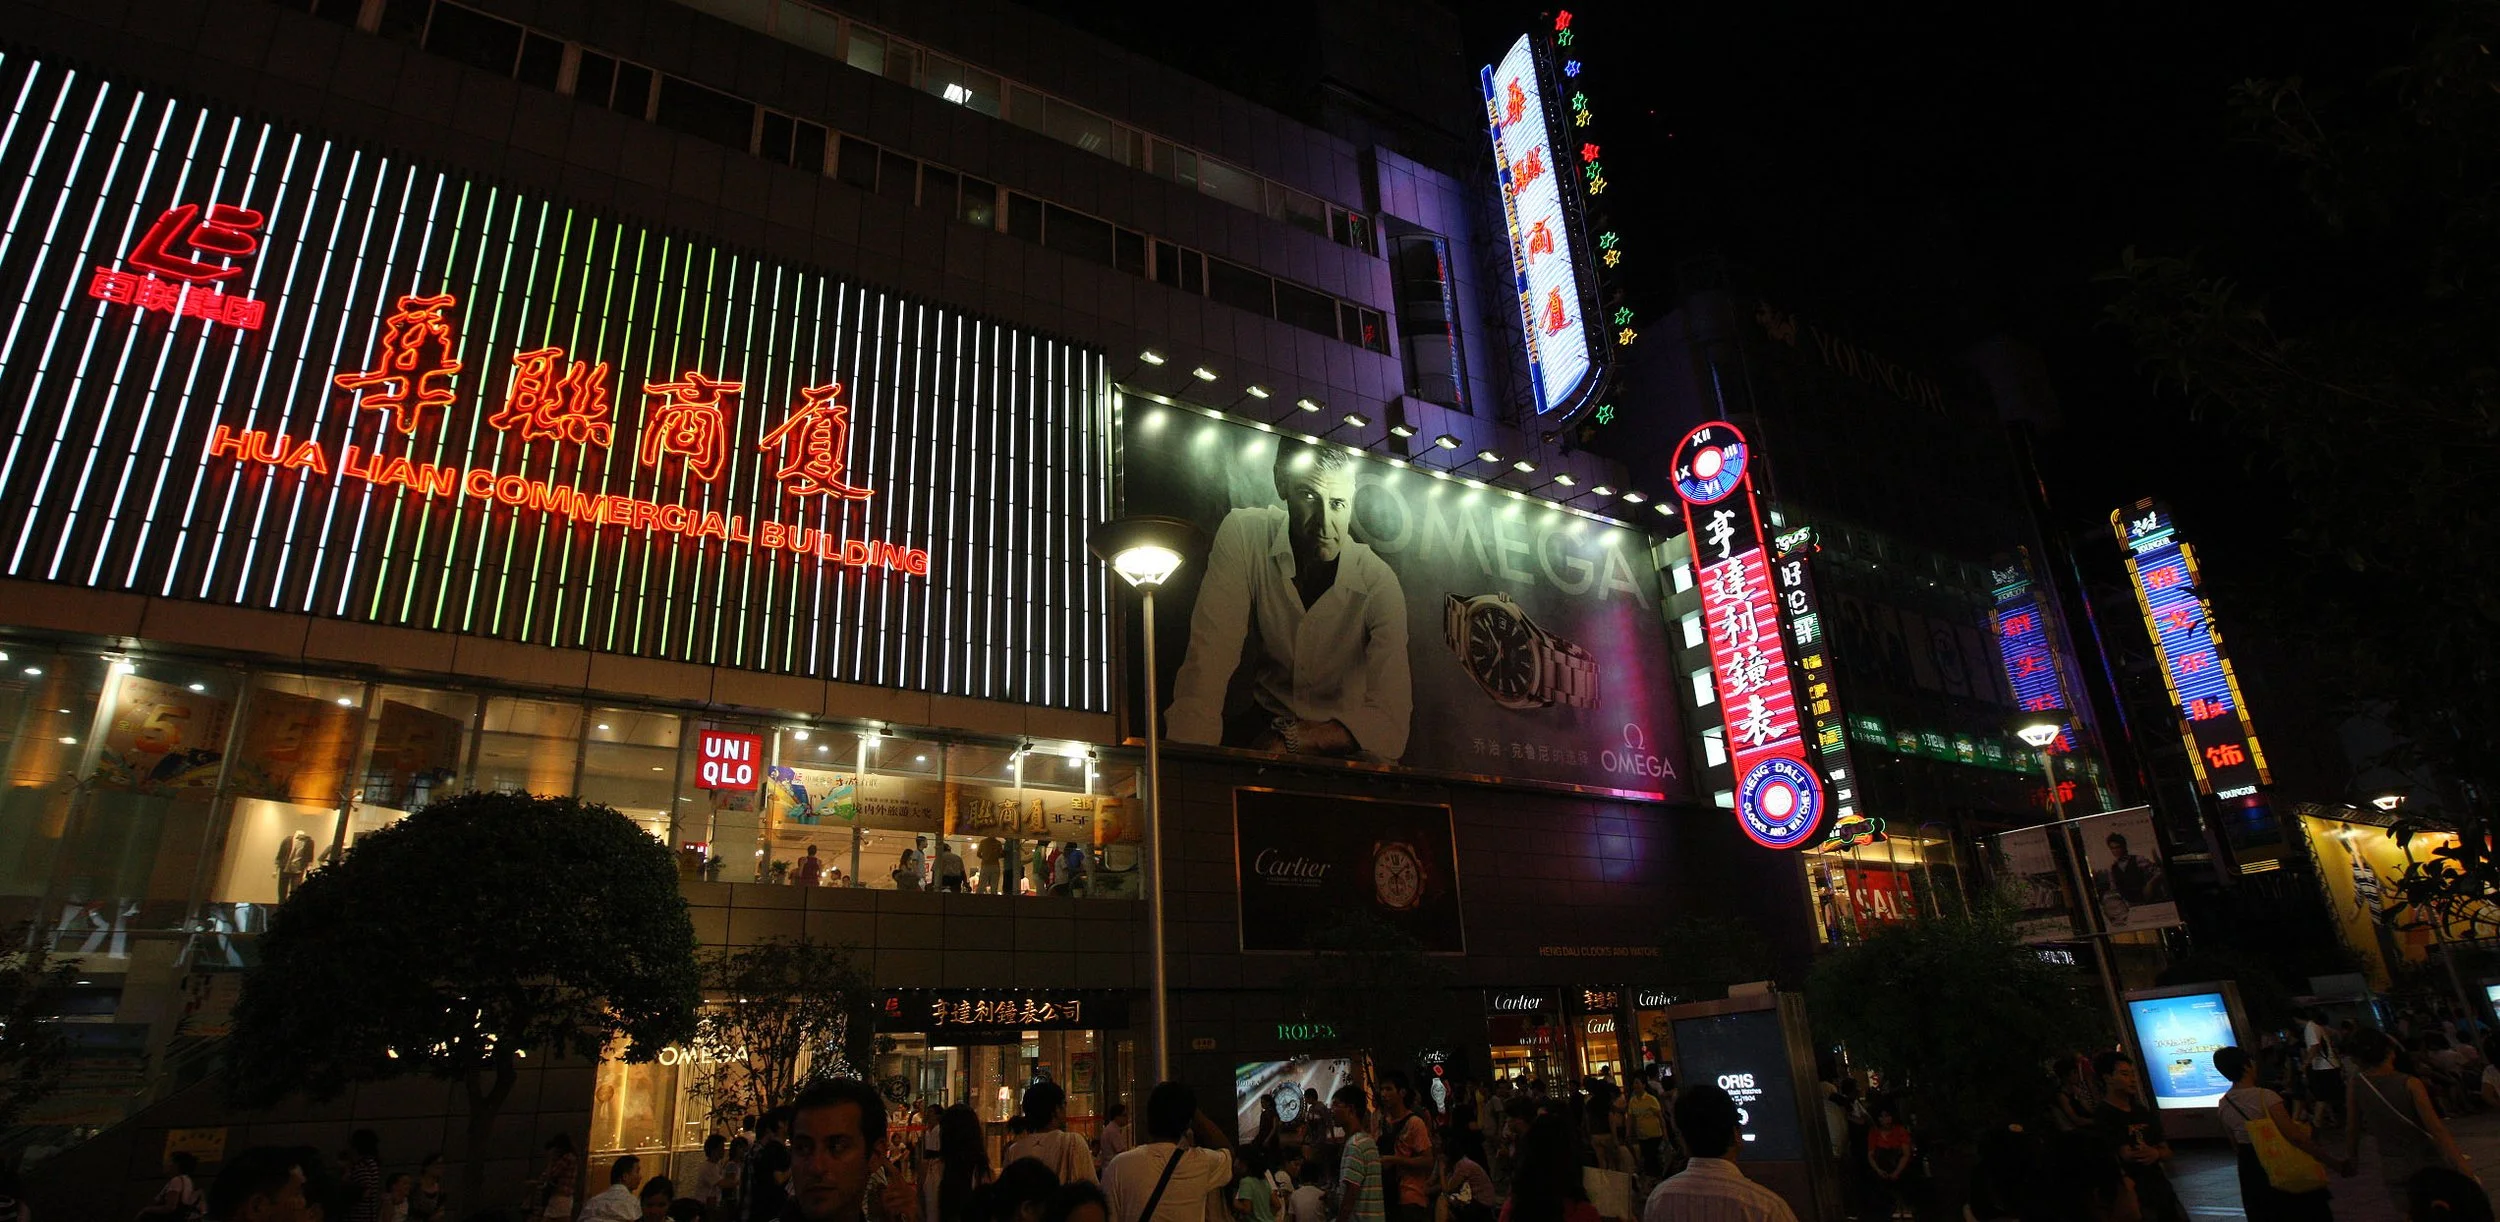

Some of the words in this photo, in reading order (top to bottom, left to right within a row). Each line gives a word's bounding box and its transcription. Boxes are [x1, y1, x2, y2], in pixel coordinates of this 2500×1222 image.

[88, 265, 267, 331] 百联集团
[210, 424, 328, 475] HUA
[342, 445, 457, 498] LIAN
[464, 468, 751, 544] COMMERCIAL
[760, 519, 930, 577] BUILDING
[1346, 470, 1650, 611] OMEGA
[2136, 536, 2171, 554] YOUNGOR
[704, 736, 751, 763] UNI
[702, 760, 753, 787] QLO
[1600, 749, 1677, 780] OMEGA
[1743, 765, 1770, 797] HENG
[1774, 762, 1805, 784] DALI
[2216, 785, 2258, 801] YOUNGOR
[1743, 802, 1768, 833] CLOCKS
[1769, 826, 1788, 837] AND
[1788, 789, 1811, 831] WATCHES
[1254, 847, 1332, 878] Cartier
[1855, 887, 1918, 921] SALE
[1630, 946, 1660, 957] WATCHE
[1494, 993, 1544, 1011] Cartier
[658, 1044, 749, 1066] OMEGA
[1717, 1073, 1755, 1090] ORIS
